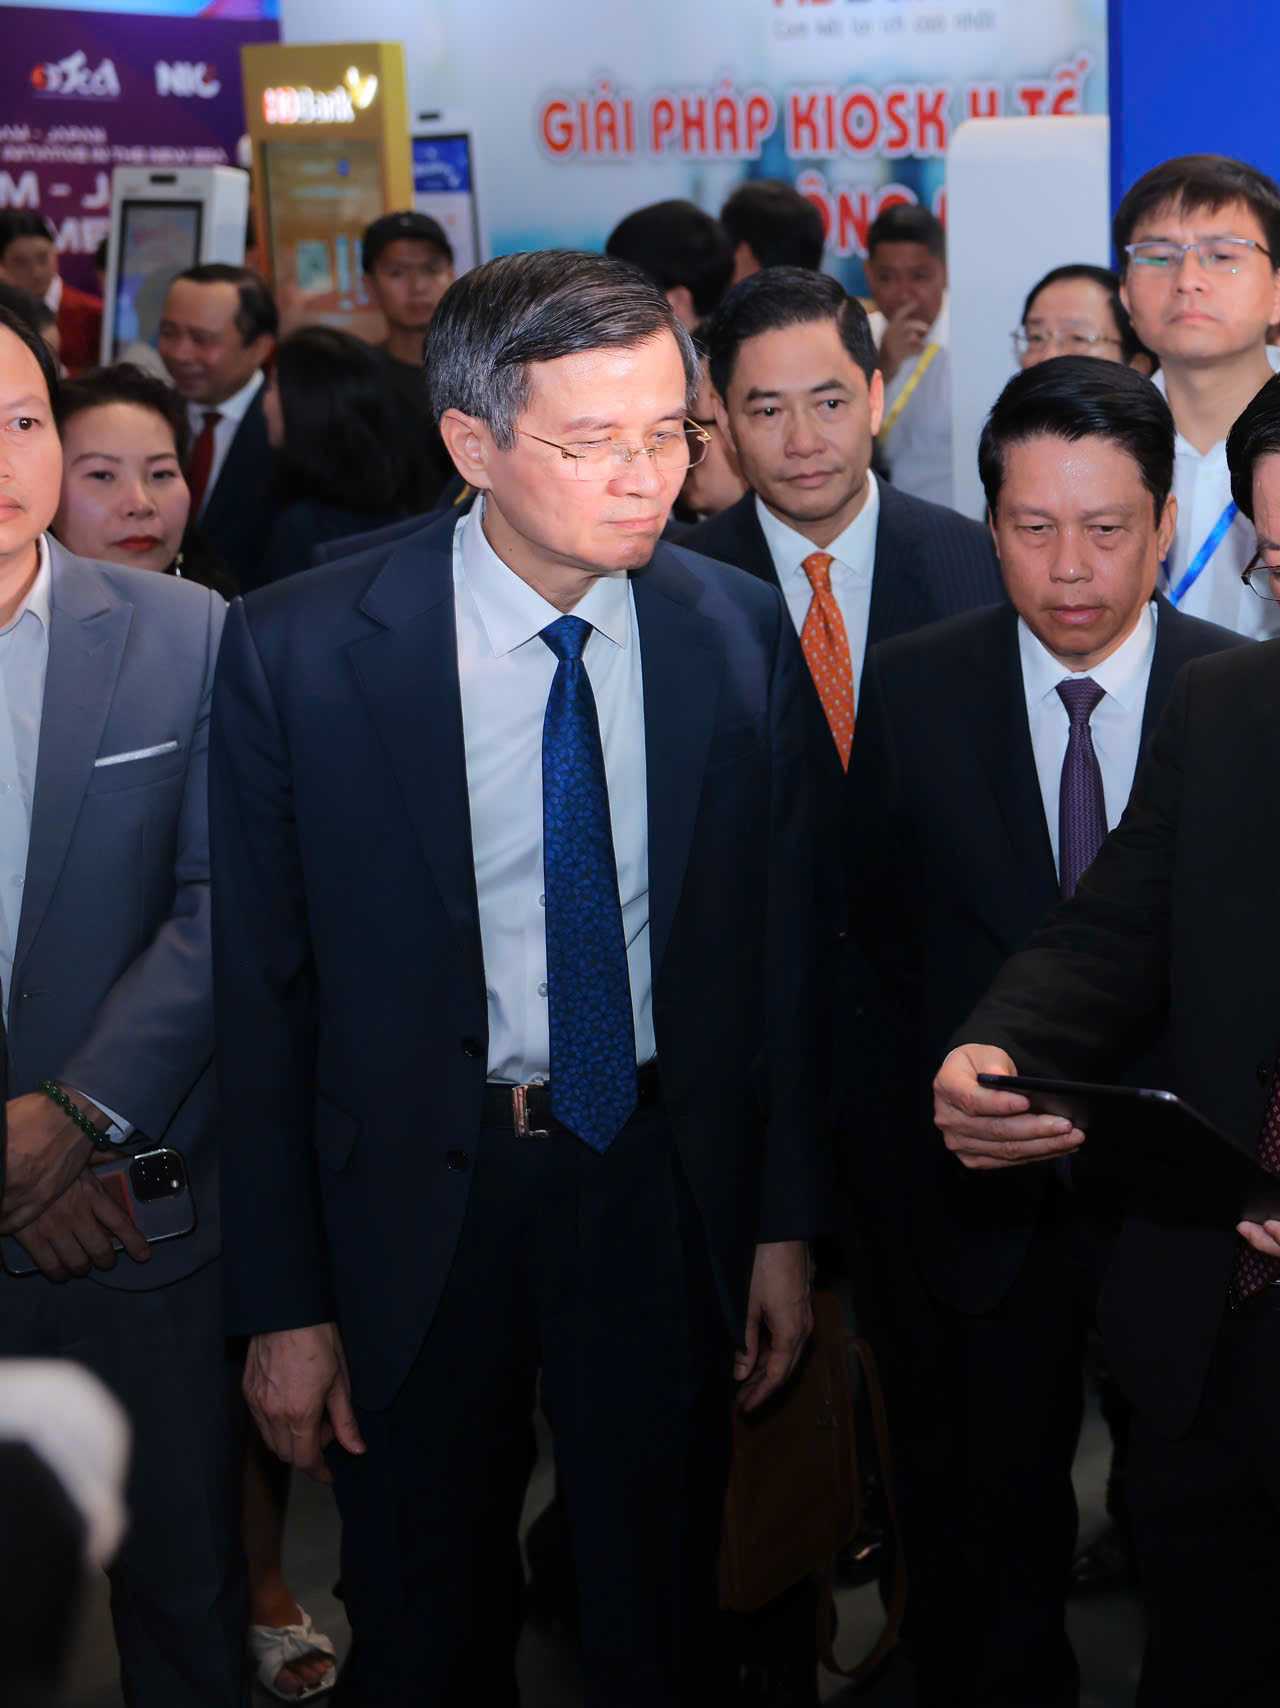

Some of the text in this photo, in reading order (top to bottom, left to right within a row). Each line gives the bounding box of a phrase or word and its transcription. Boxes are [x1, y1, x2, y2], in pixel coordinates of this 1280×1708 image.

[541, 77, 634, 154] GIẢI
[652, 77, 771, 154] PHÁP
[790, 89, 947, 152] KIOSK
